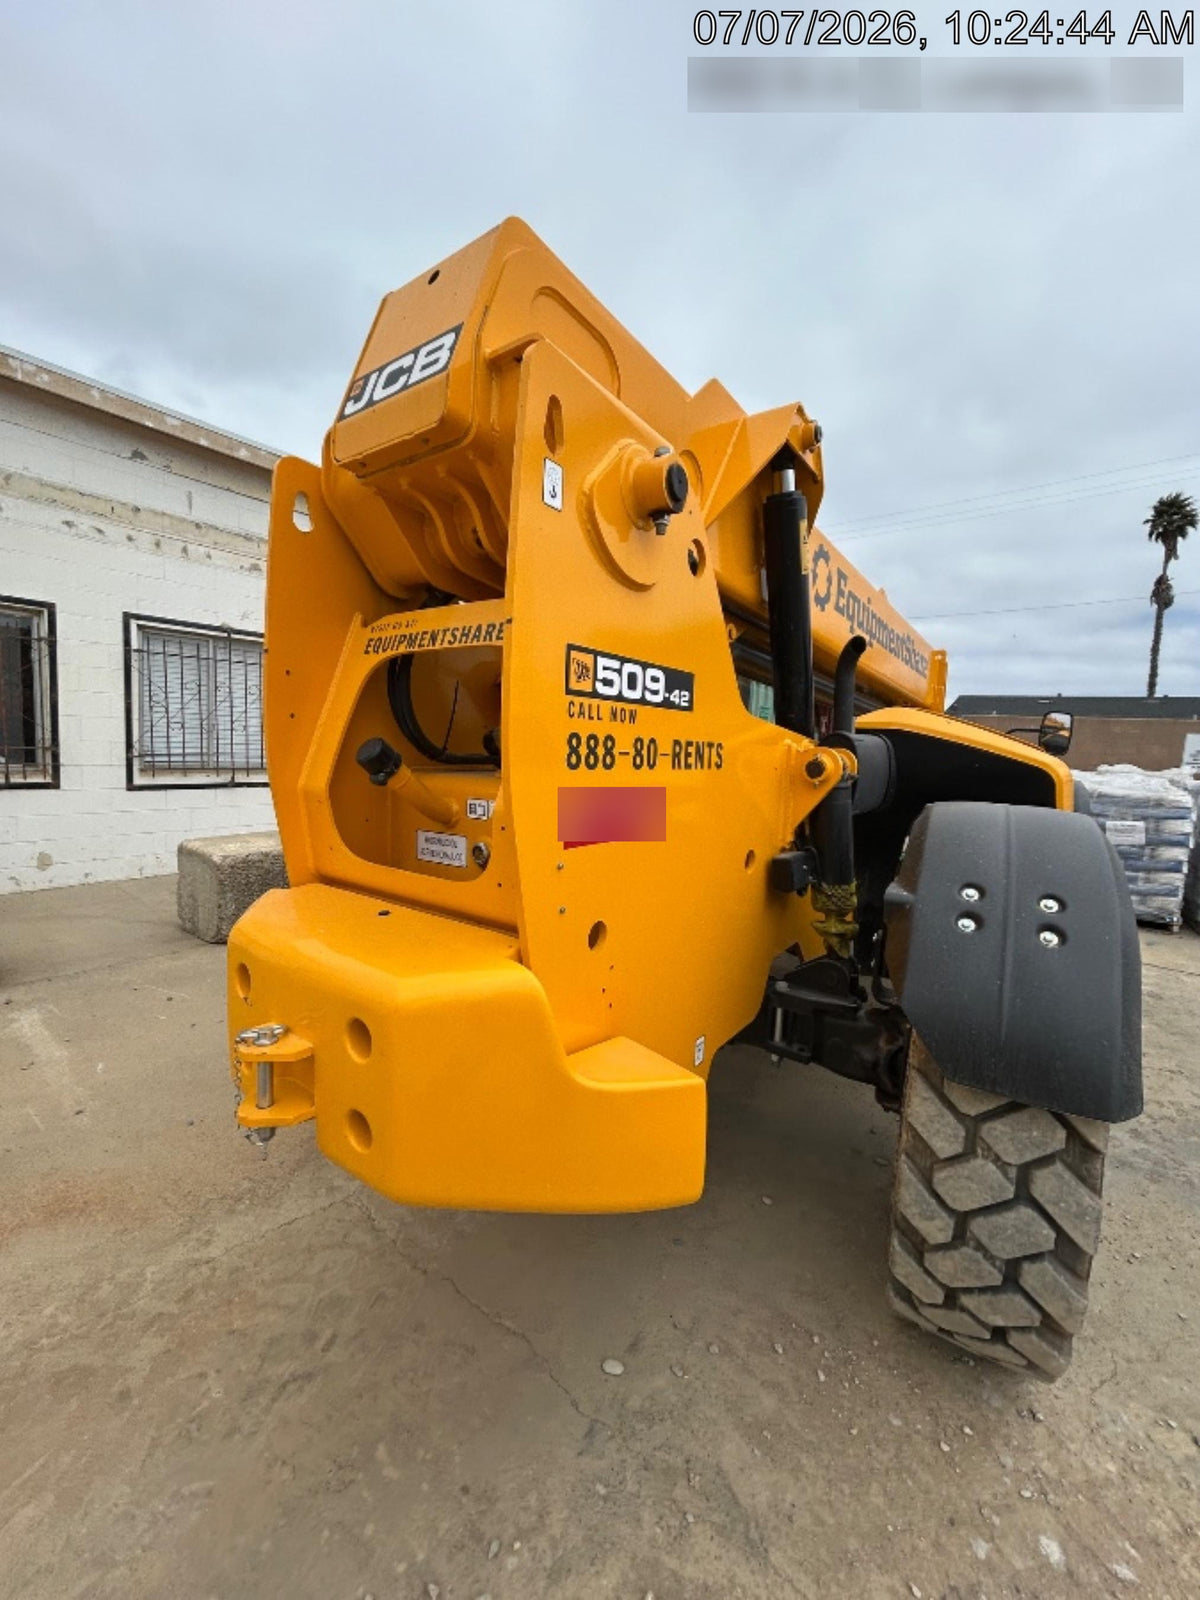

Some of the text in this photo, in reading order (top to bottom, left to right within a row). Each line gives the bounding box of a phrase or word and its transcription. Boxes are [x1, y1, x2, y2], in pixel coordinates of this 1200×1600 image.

[343, 331, 456, 417] JCB
[567, 700, 638, 725] CALL NOW
[566, 731, 724, 771] 888-80-RENTS
